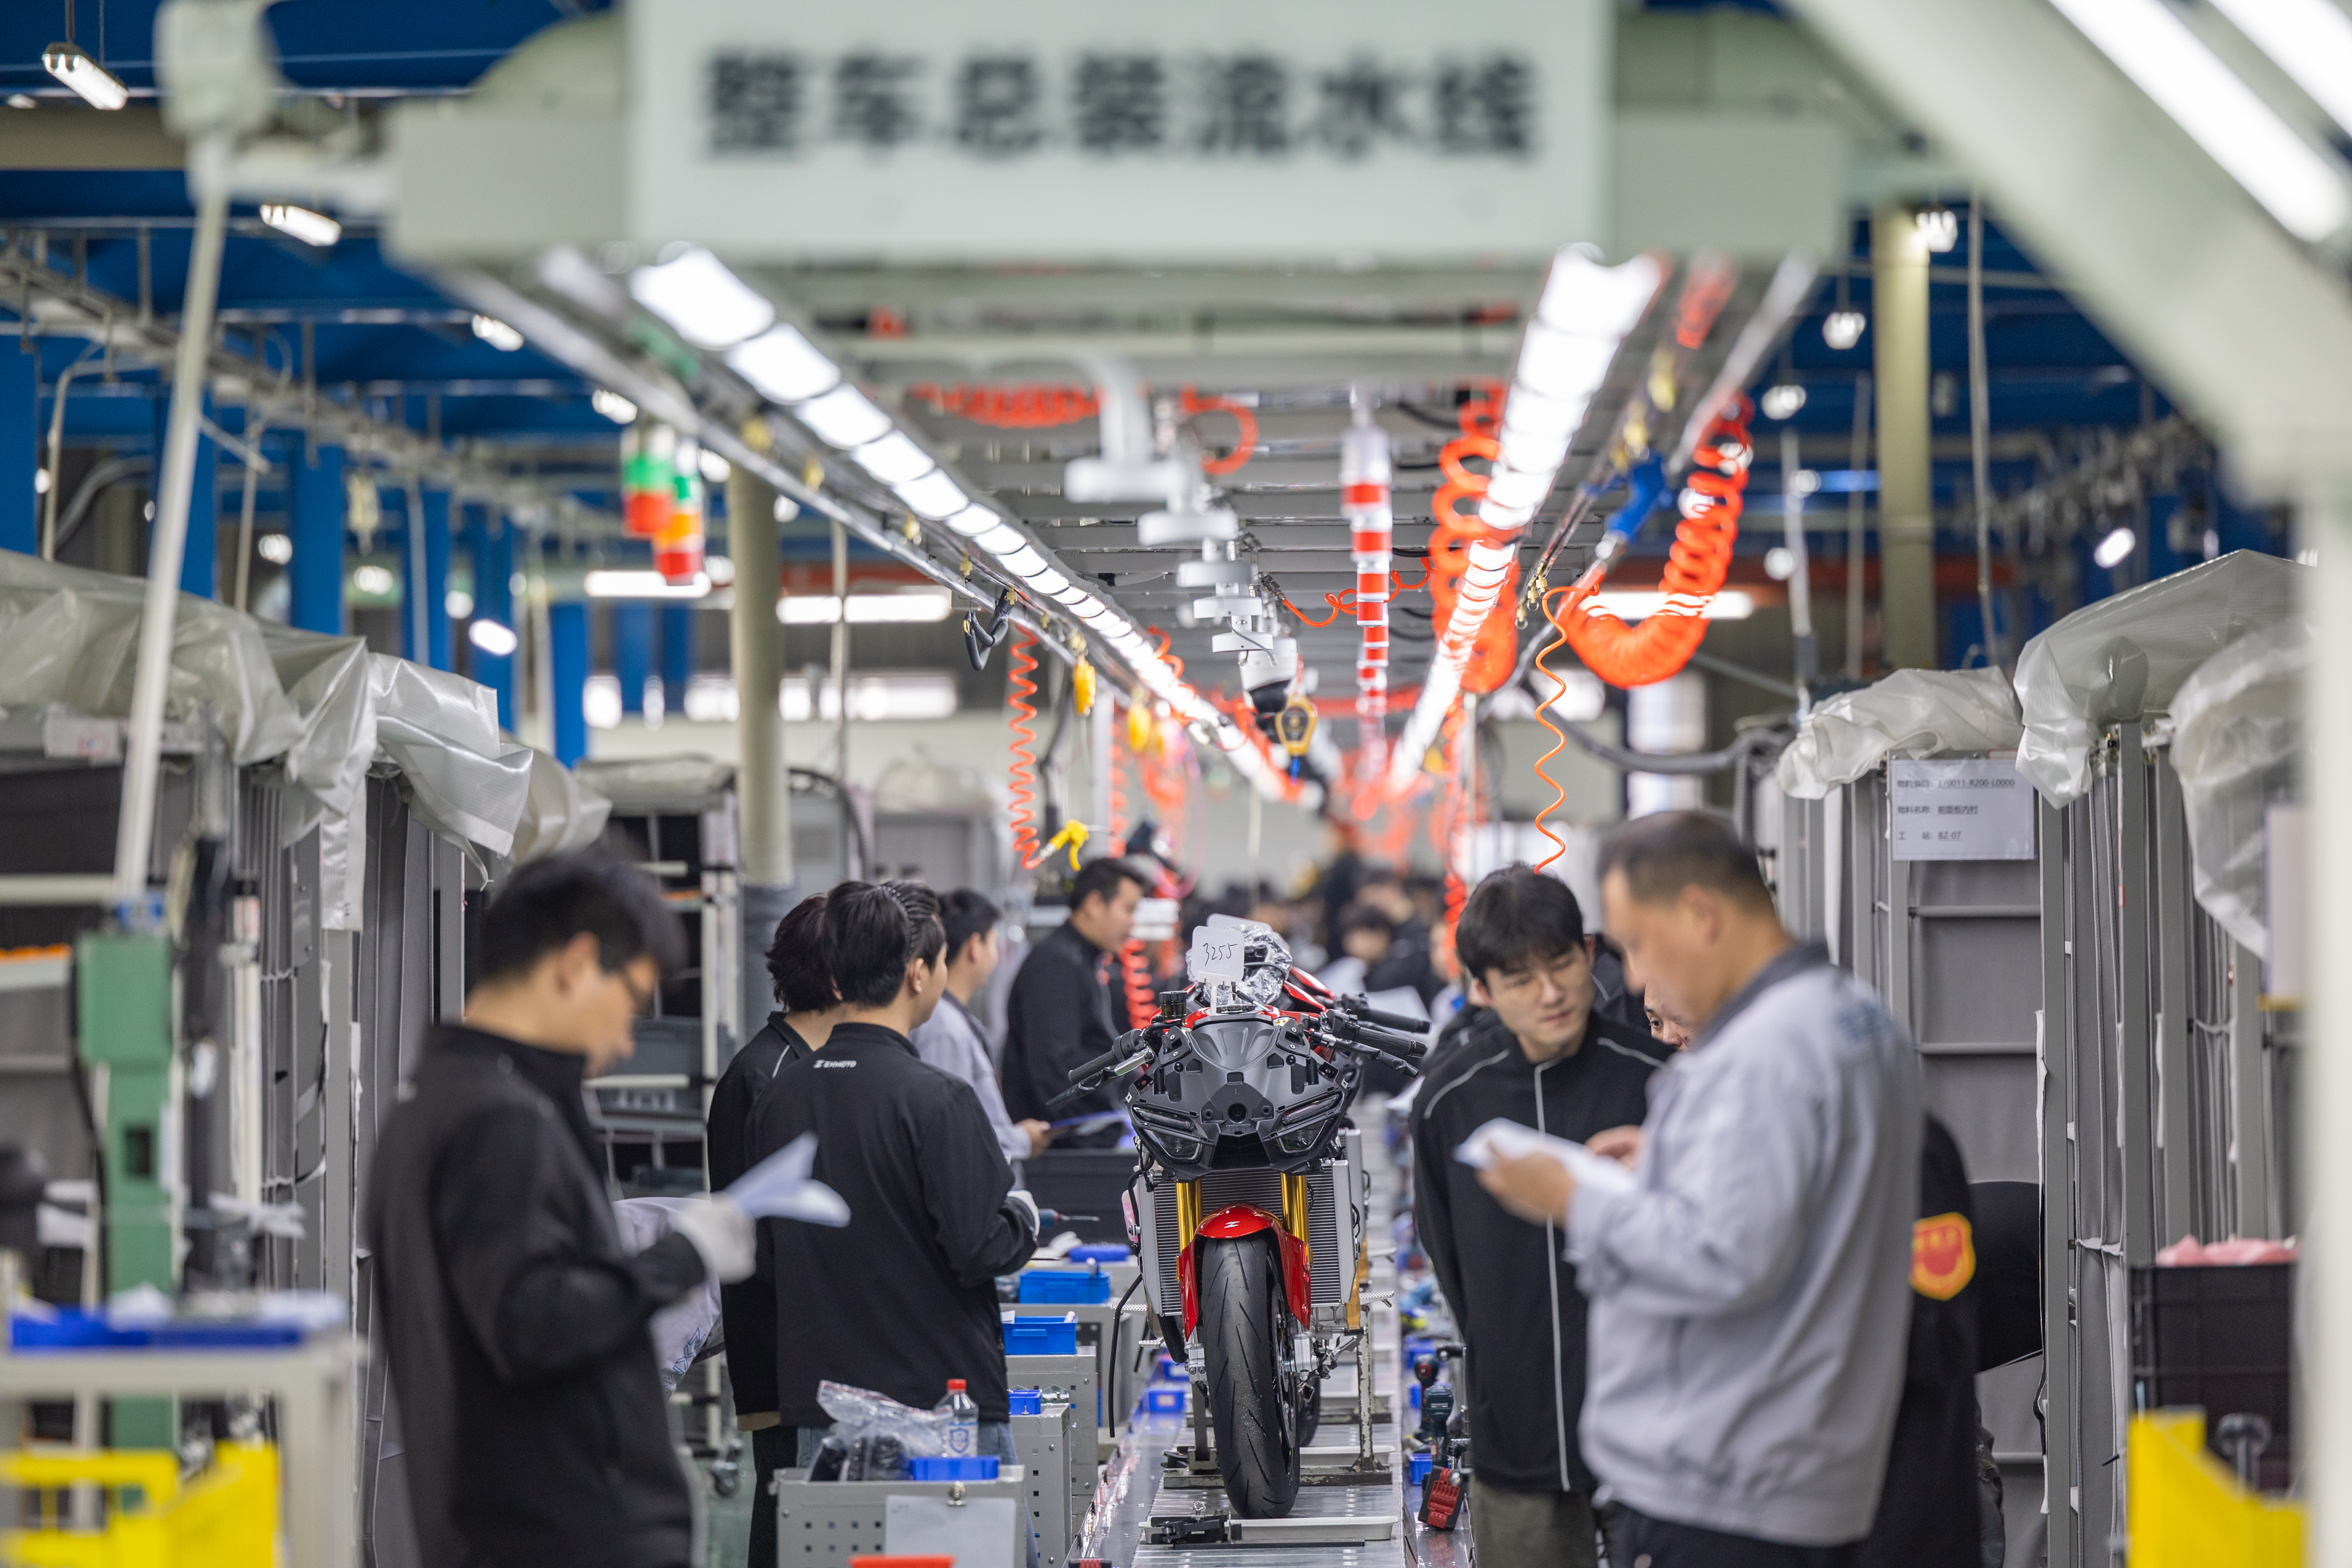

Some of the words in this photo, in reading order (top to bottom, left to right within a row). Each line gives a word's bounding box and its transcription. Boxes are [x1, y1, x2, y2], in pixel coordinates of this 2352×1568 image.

[704, 52, 1538, 159] 整车总装流水线
[1202, 942, 1238, 966] 3255
